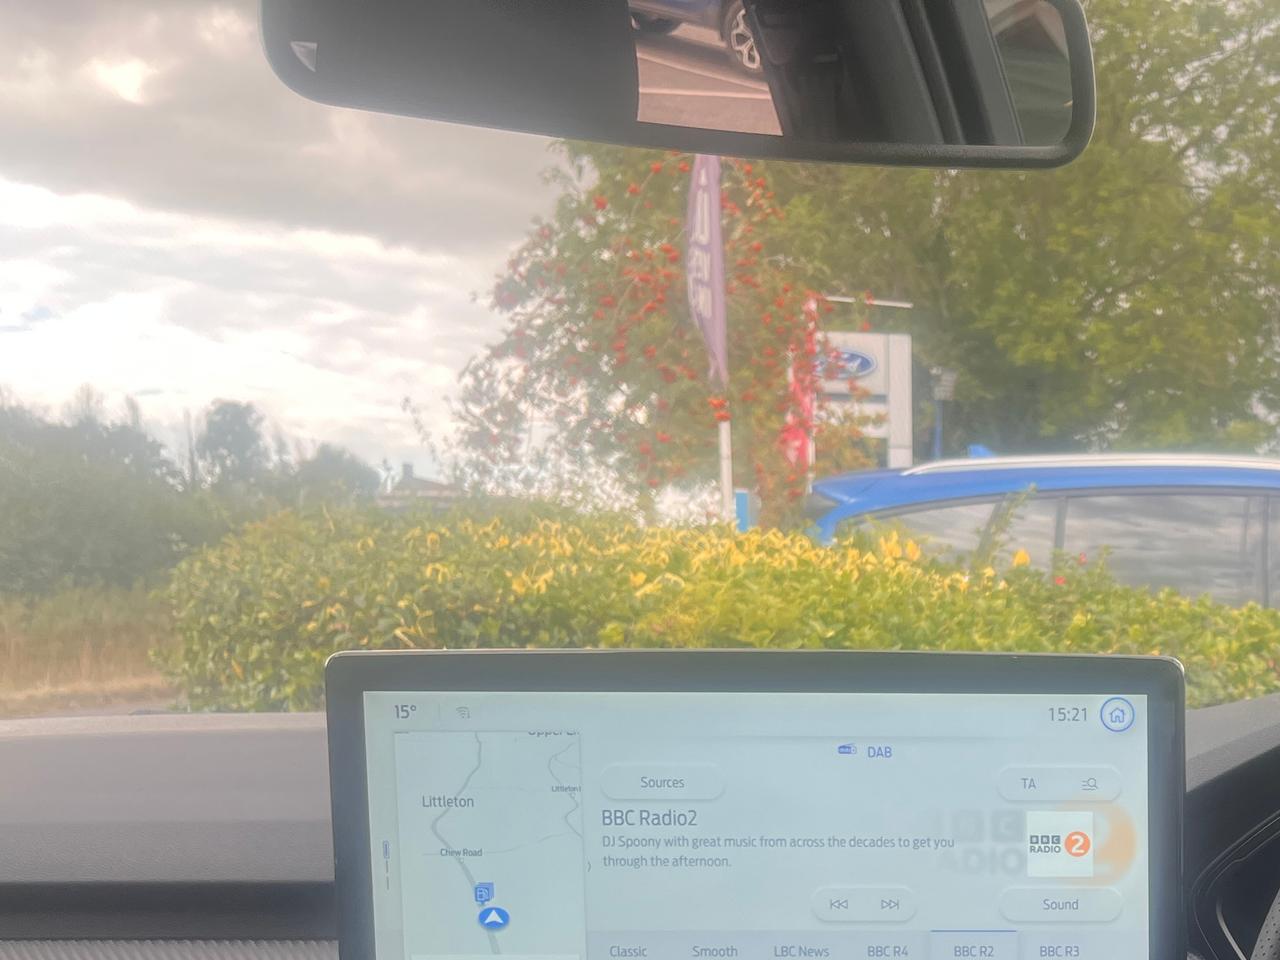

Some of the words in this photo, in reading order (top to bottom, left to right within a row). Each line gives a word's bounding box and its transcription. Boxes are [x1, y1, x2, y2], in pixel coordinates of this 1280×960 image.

[394, 704, 417, 719] 15°
[1048, 707, 1087, 722] 15:21
[867, 745, 893, 759] DAB
[640, 776, 685, 789] Sources
[1020, 777, 1037, 790] TA
[422, 795, 475, 808] Littleton
[601, 809, 636, 826] BBC
[639, 808, 698, 826] Radio2
[602, 835, 616, 848] DJ
[617, 835, 662, 849] Spoony
[663, 835, 690, 848] with
[691, 836, 722, 850] great
[723, 835, 757, 848] music
[759, 835, 787, 848] from
[789, 837, 826, 848] across
[827, 835, 847, 848] the
[848, 835, 896, 848] decades
[897, 837, 911, 848] to
[912, 837, 931, 850] get
[933, 838, 955, 850] you
[1029, 835, 1061, 845] BBC
[1071, 835, 1085, 854] 2
[459, 847, 483, 857] Road
[1029, 846, 1061, 854] RADIO
[602, 855, 648, 870] through
[650, 855, 670, 867] the
[671, 854, 732, 868] afternoon.
[1042, 898, 1079, 911] Sound
[609, 945, 648, 958] Classic
[692, 945, 738, 958] Smooth
[773, 945, 797, 958] LBC
[798, 945, 830, 958] News
[867, 945, 891, 958] BBC
[893, 945, 909, 958] R4
[953, 945, 977, 958] BBC
[979, 945, 994, 958] R2
[1039, 945, 1063, 958] BBC
[1064, 945, 1080, 957] R3
